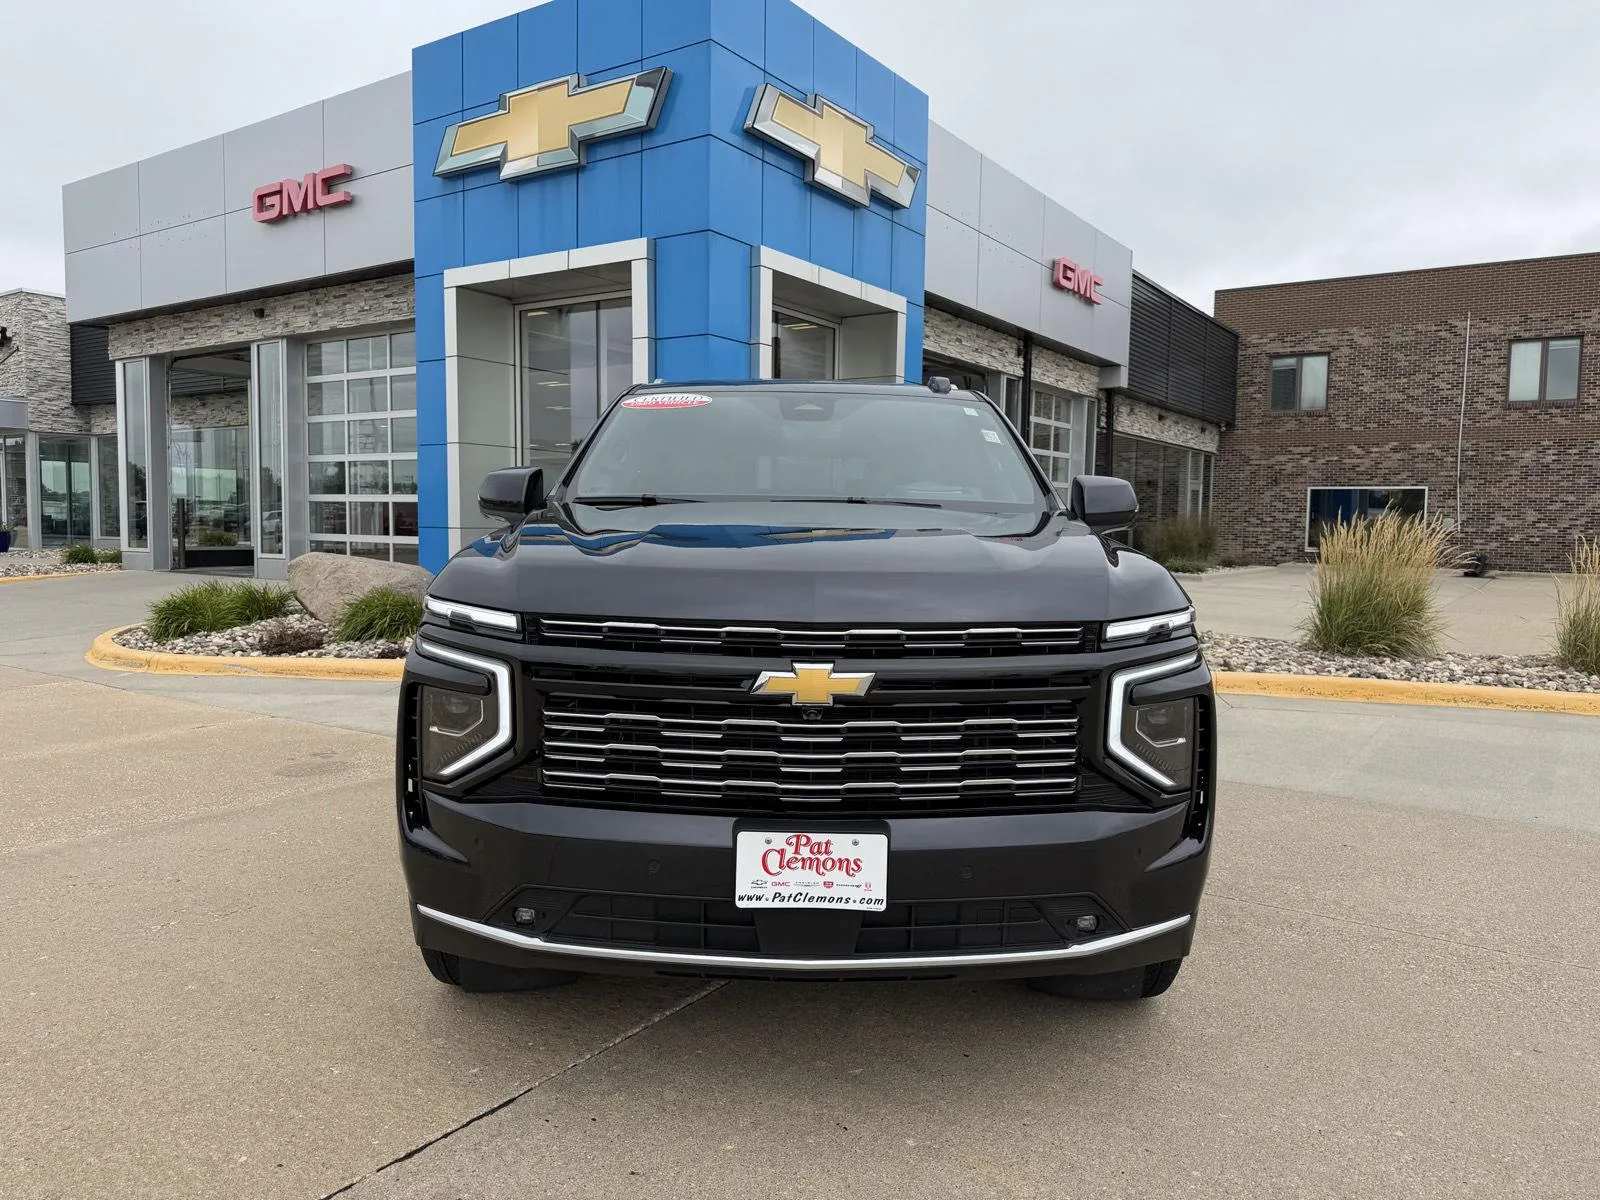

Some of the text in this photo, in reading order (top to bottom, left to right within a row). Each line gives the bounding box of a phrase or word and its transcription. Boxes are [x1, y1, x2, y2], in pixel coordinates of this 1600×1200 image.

[252, 163, 352, 223] GMC
[1055, 256, 1104, 305] GMC
[761, 848, 863, 877] Clemons
[785, 833, 833, 856] Pat
